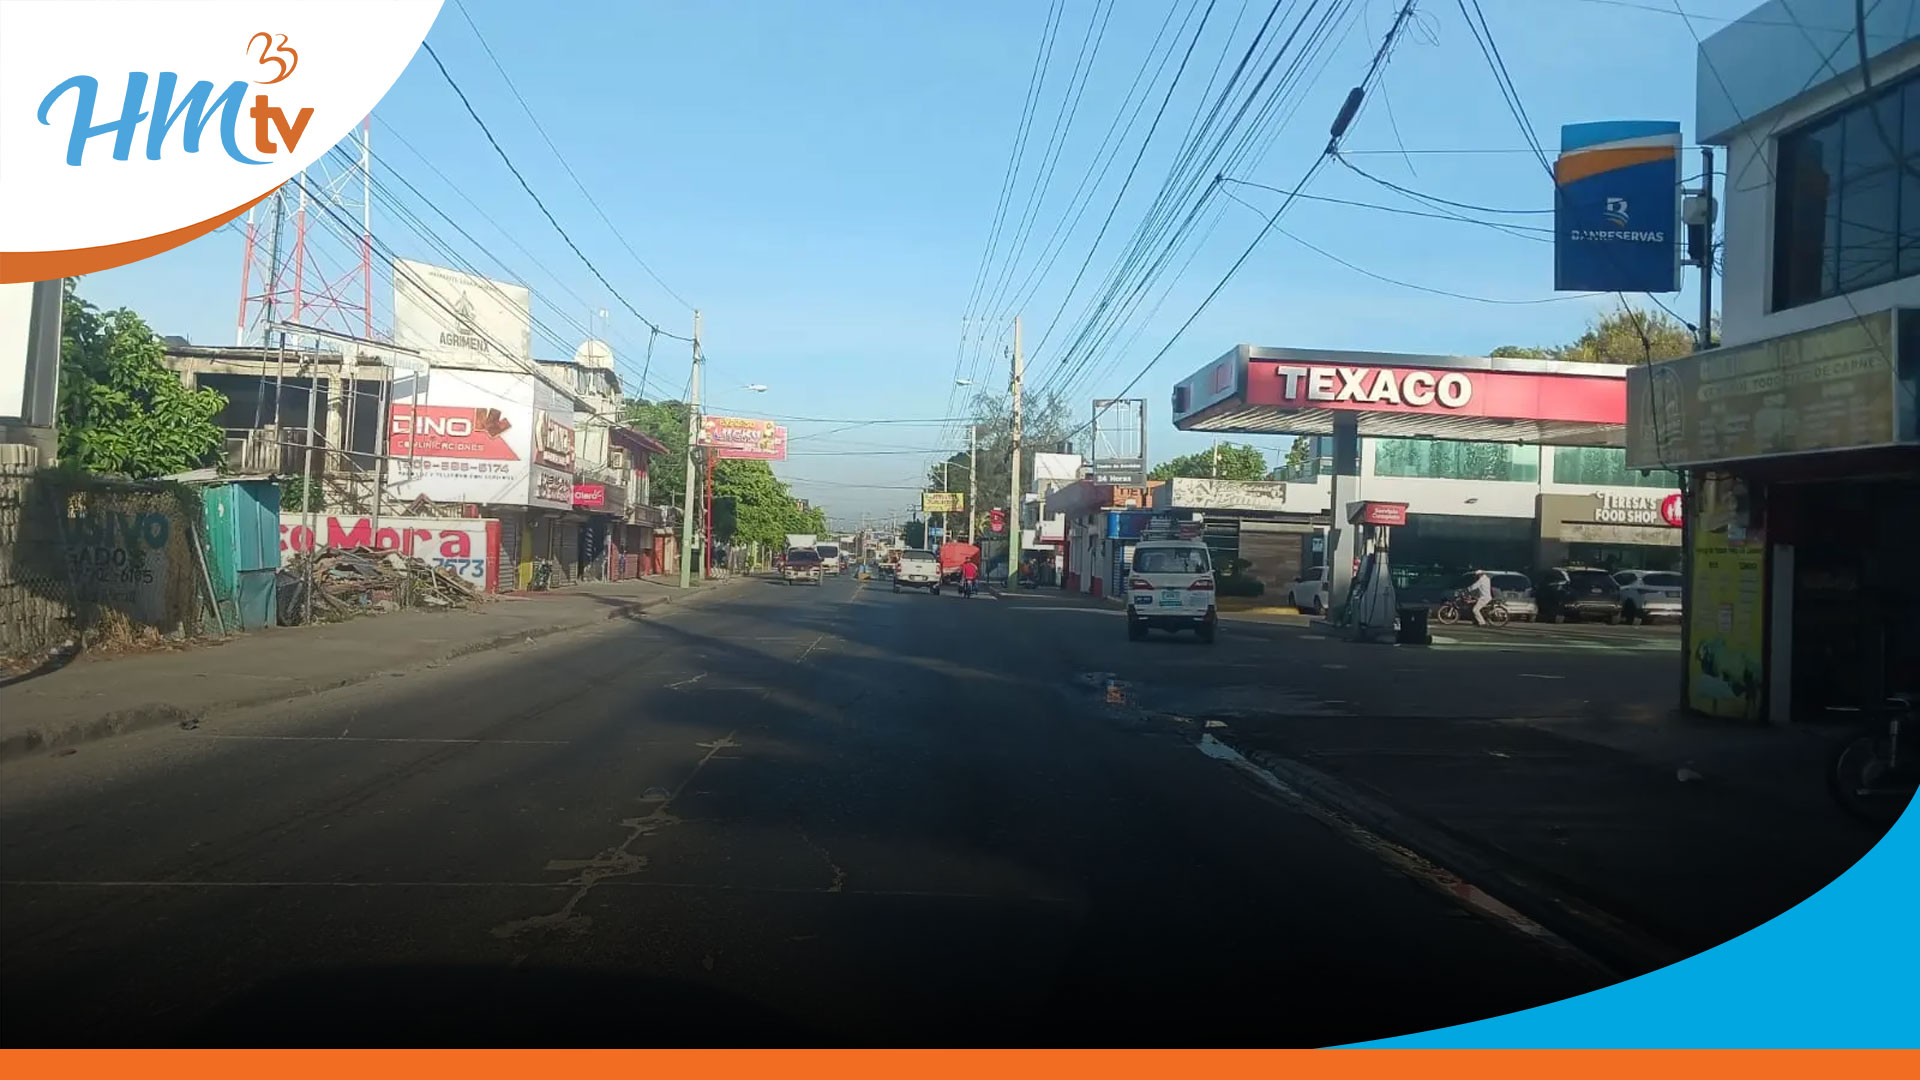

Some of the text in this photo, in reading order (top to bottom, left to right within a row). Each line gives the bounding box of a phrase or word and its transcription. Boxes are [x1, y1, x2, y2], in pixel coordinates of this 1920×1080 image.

[1278, 366, 1472, 408] TEXACO
[392, 415, 472, 437] DINO
[1595, 508, 1658, 523] FOOD SHOP
[327, 517, 472, 558] Mora
